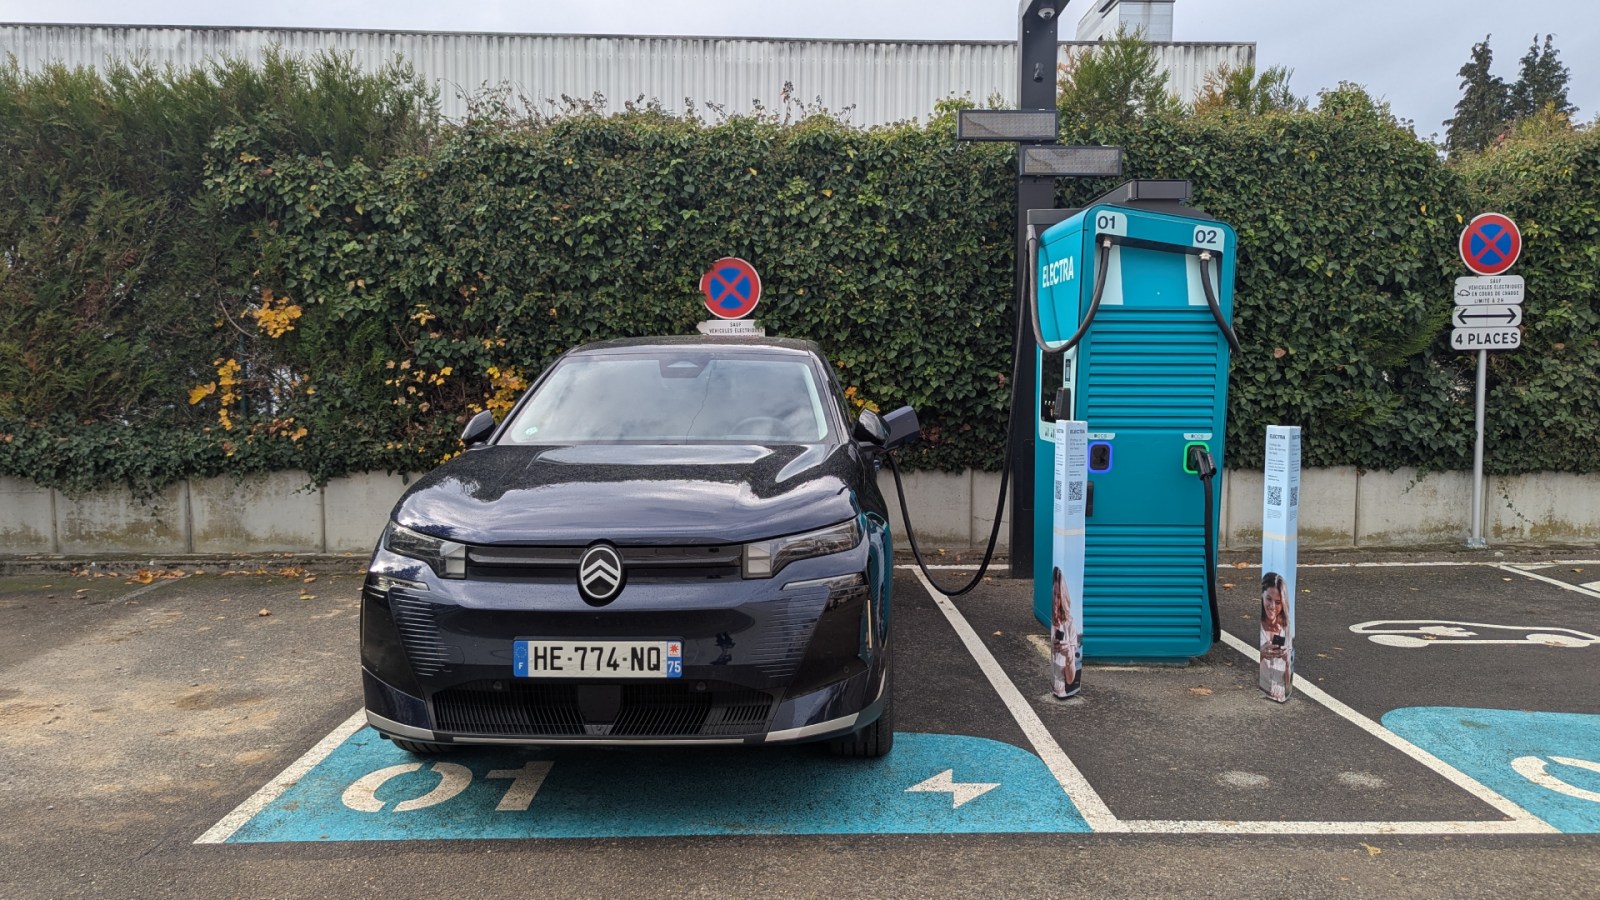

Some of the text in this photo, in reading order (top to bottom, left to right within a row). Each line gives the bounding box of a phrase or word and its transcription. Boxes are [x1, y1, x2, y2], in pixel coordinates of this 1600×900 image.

[1097, 215, 1116, 230] 01
[1195, 229, 1217, 244] 02
[1042, 255, 1075, 288] ELECTRA
[1455, 332, 1518, 345] 4 PLACES
[518, 662, 524, 670] F
[533, 646, 661, 671] HE-774-NQ
[667, 660, 681, 673] 75
[341, 760, 555, 813] 01
